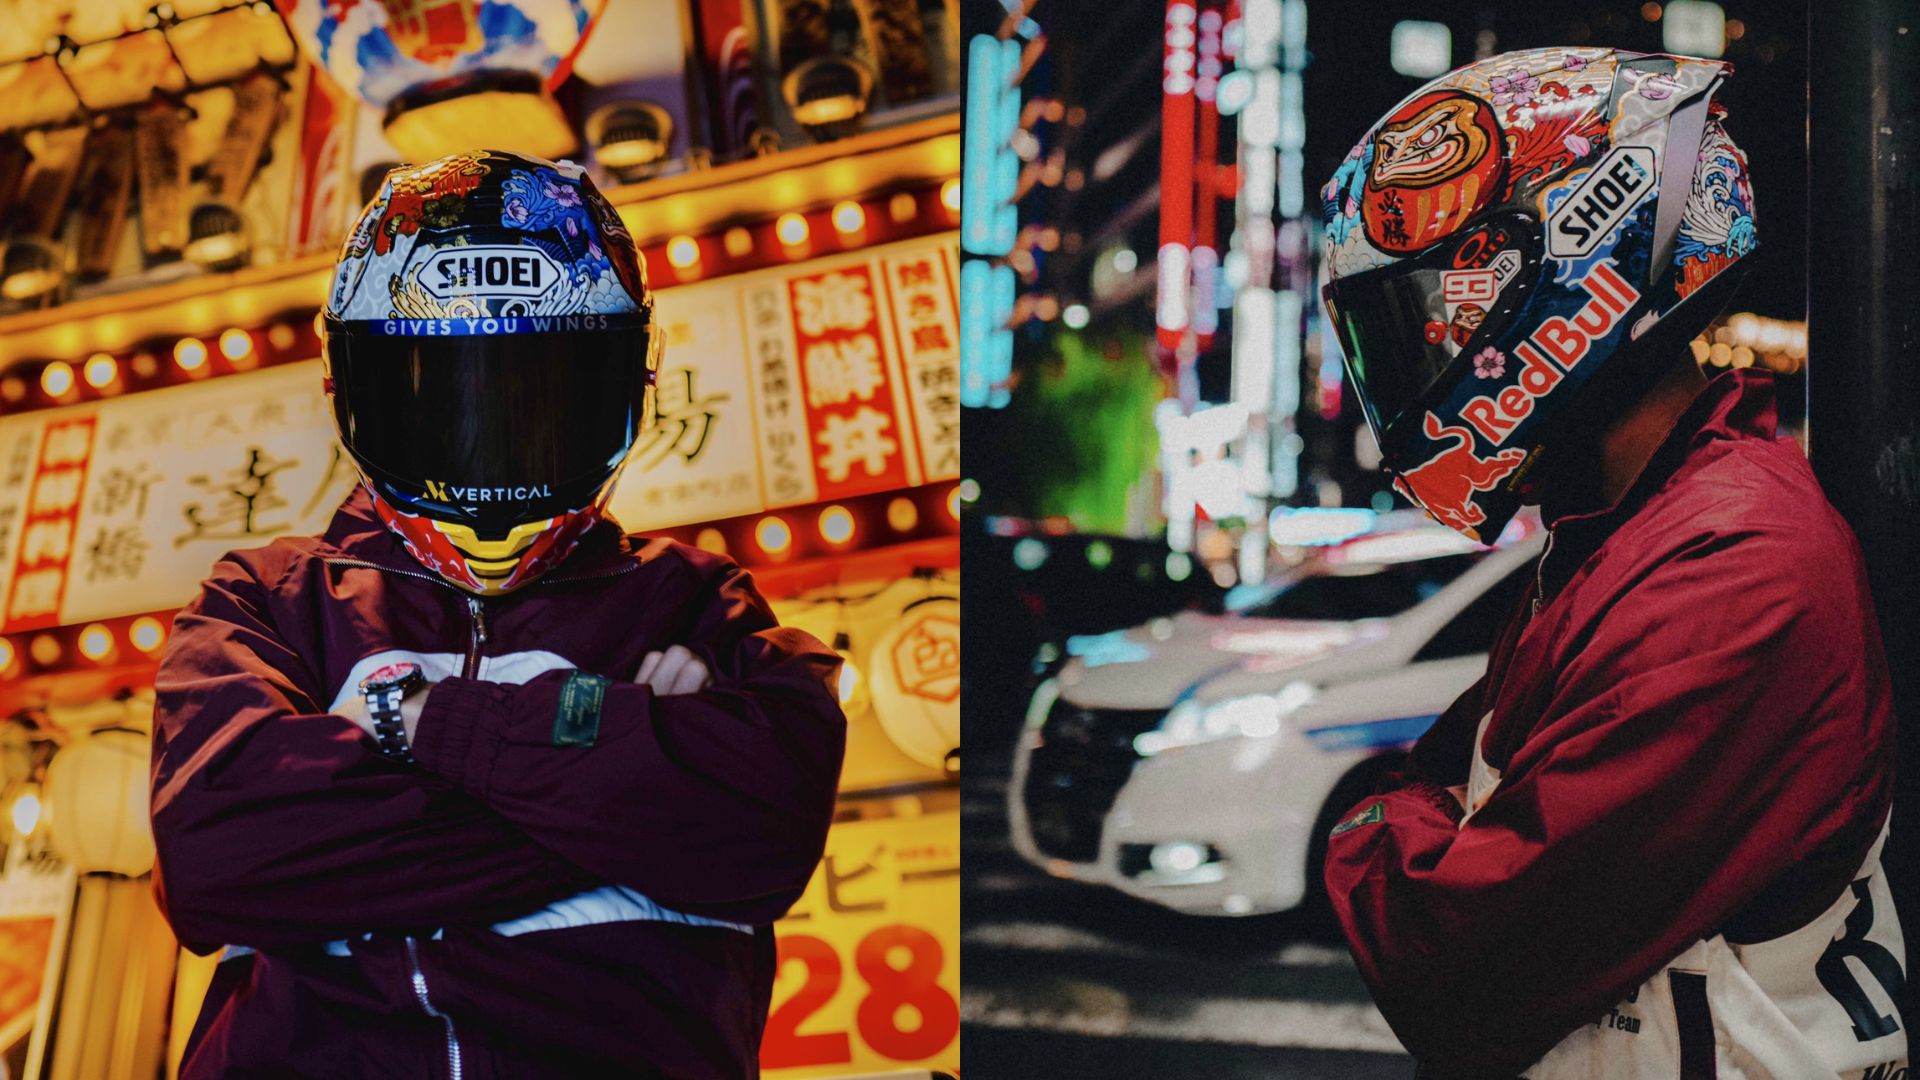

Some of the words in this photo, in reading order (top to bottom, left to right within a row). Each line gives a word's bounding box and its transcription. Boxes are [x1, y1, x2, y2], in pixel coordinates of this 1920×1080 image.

[1560, 155, 1649, 248] SHOEI
[437, 256, 541, 289] SHOEI
[1444, 272, 1494, 302] 93
[384, 319, 451, 336] GIVES
[465, 317, 518, 335] YOU
[532, 314, 608, 333] WINGS
[793, 272, 896, 483] 海鮮丼
[451, 483, 552, 502] VERTICAL
[85, 462, 164, 584] 新橋
[1608, 1008, 1642, 1035] Team
